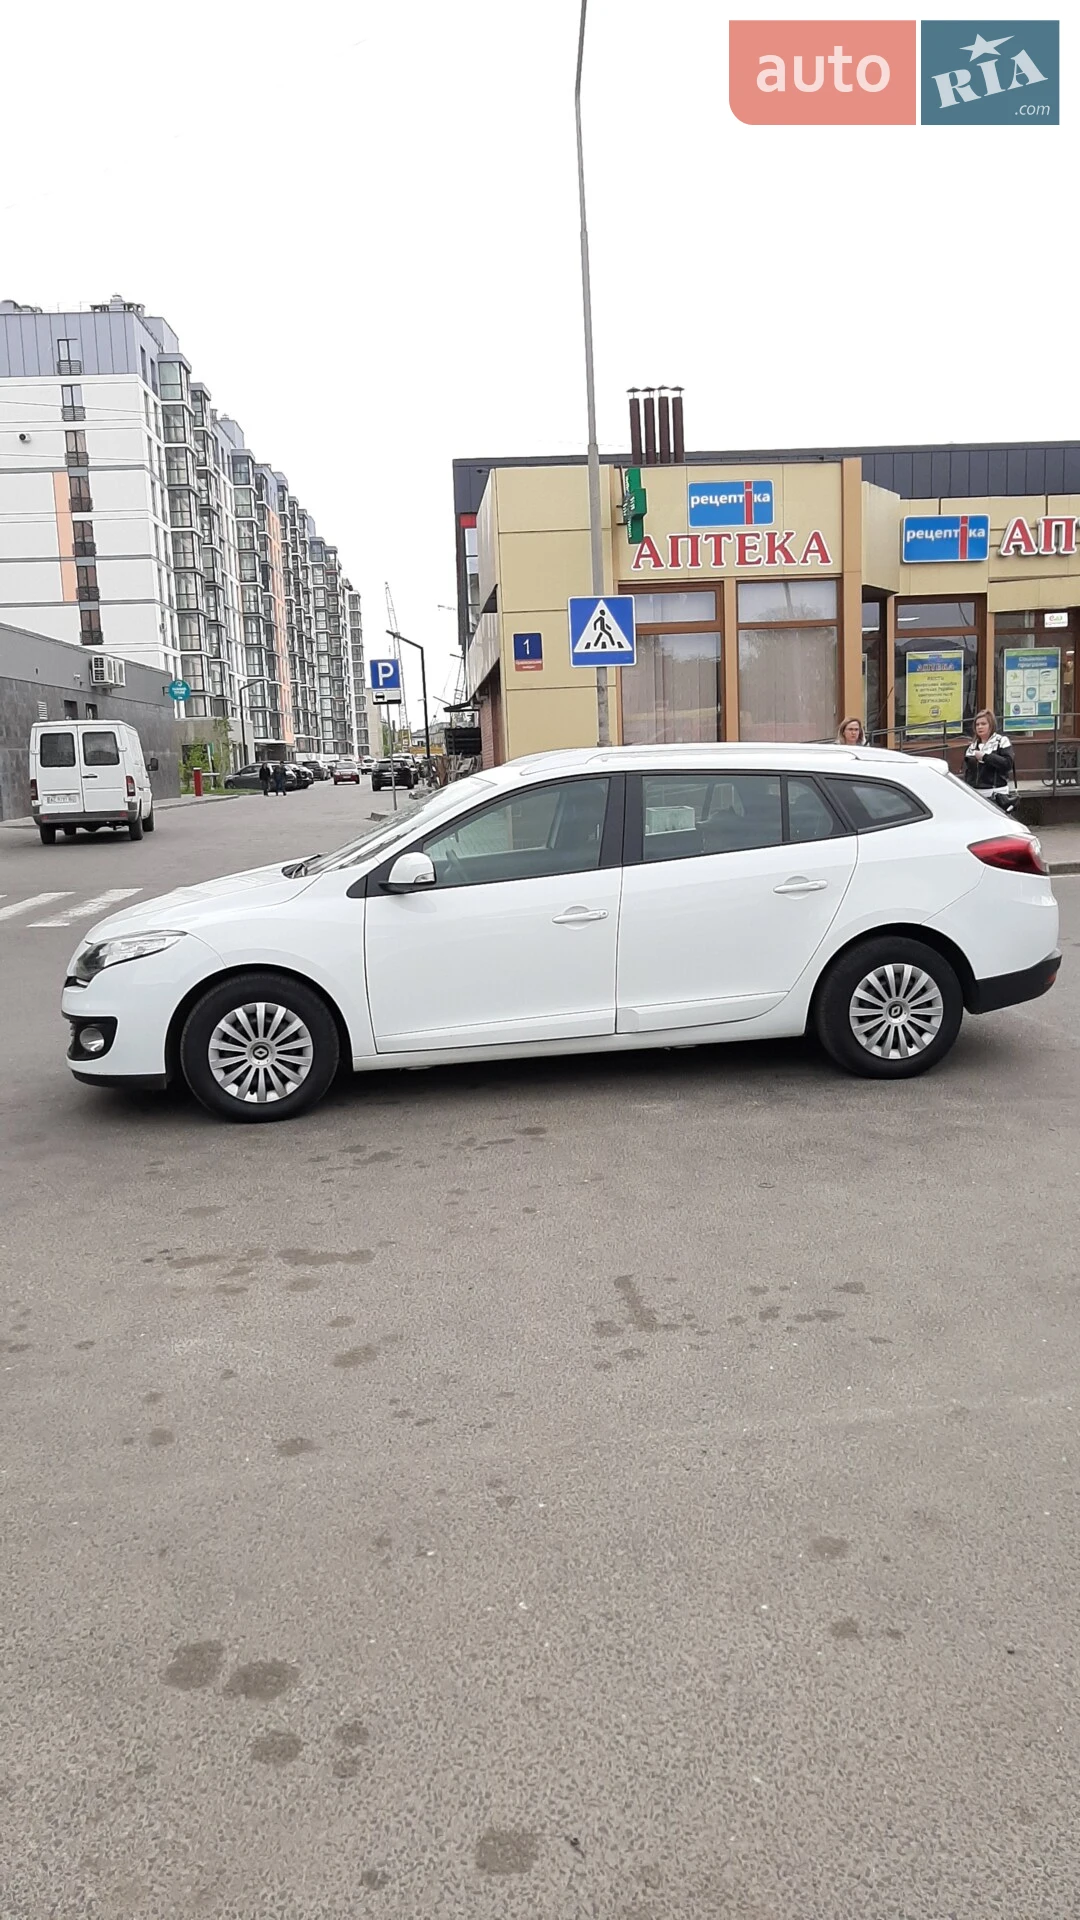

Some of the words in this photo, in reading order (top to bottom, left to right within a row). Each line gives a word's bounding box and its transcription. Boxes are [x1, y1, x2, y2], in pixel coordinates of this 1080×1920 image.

[631, 530, 834, 571] АПТЕКА
[1001, 516, 1080, 556] АП
[523, 638, 530, 655] 1
[377, 662, 394, 686] P
